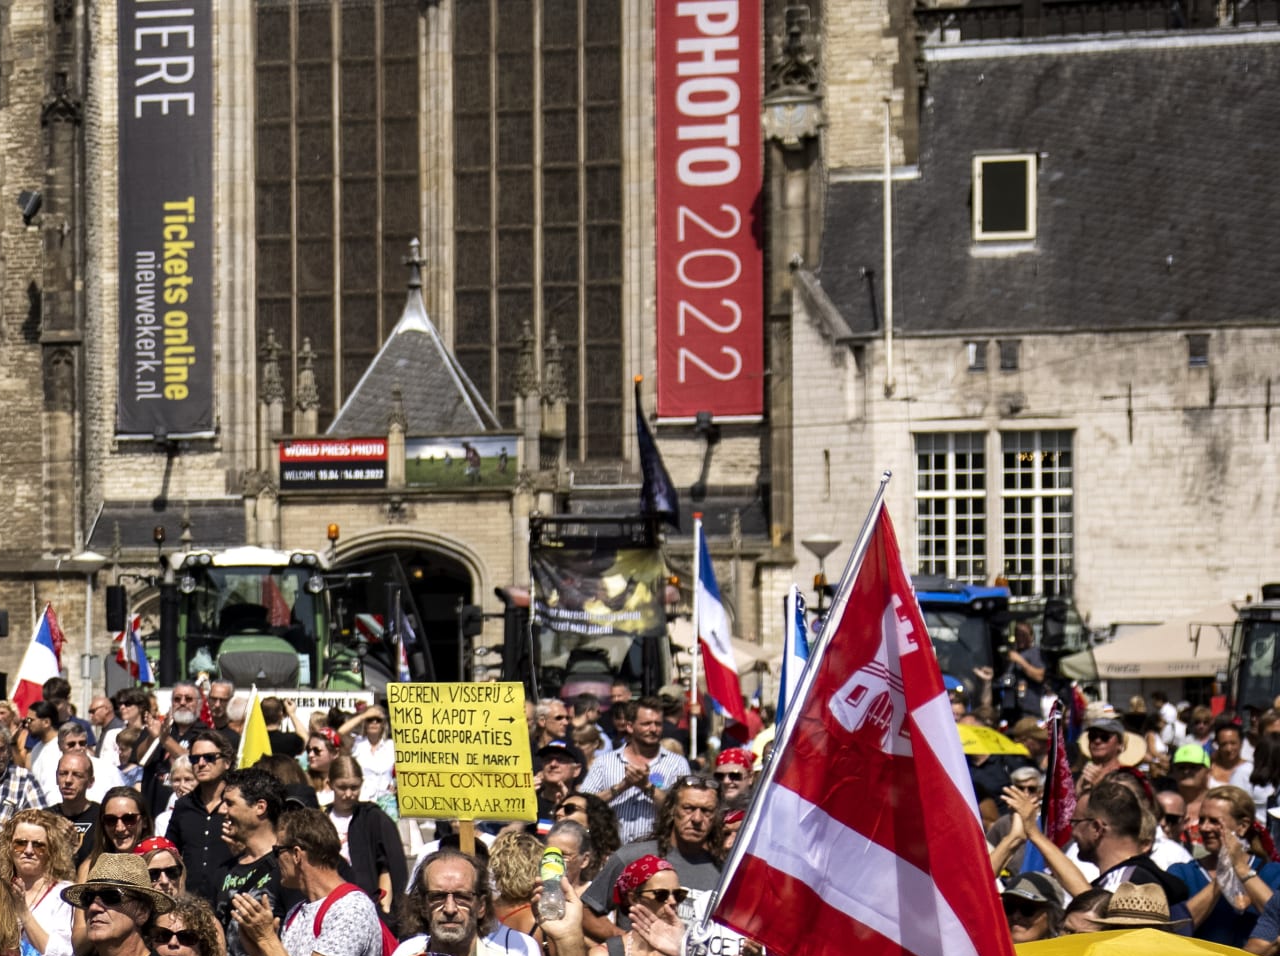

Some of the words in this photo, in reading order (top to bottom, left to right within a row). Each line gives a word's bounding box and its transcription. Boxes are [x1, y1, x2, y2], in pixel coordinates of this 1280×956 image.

[676, 0, 741, 187] PHOTO
[163, 196, 196, 304] Tickets
[676, 204, 742, 383] 2022
[135, 250, 163, 402] nieuwekerk.nl
[163, 310, 196, 401] online
[285, 445, 320, 456] WORLD
[321, 444, 351, 456] PRESS
[351, 442, 385, 456] PHOTO
[285, 470, 317, 480] WELCOME
[318, 697, 346, 708] MOVE
[503, 686, 516, 704] &
[394, 707, 423, 726] MKB
[432, 707, 477, 726] KAPOT
[394, 728, 513, 746] MEGACORPORATIES
[396, 748, 459, 766] DOMINEREN
[466, 753, 479, 765] DE
[483, 753, 520, 766] MARKT
[400, 772, 445, 788] TOTAL
[450, 772, 531, 789] CONTROL!!
